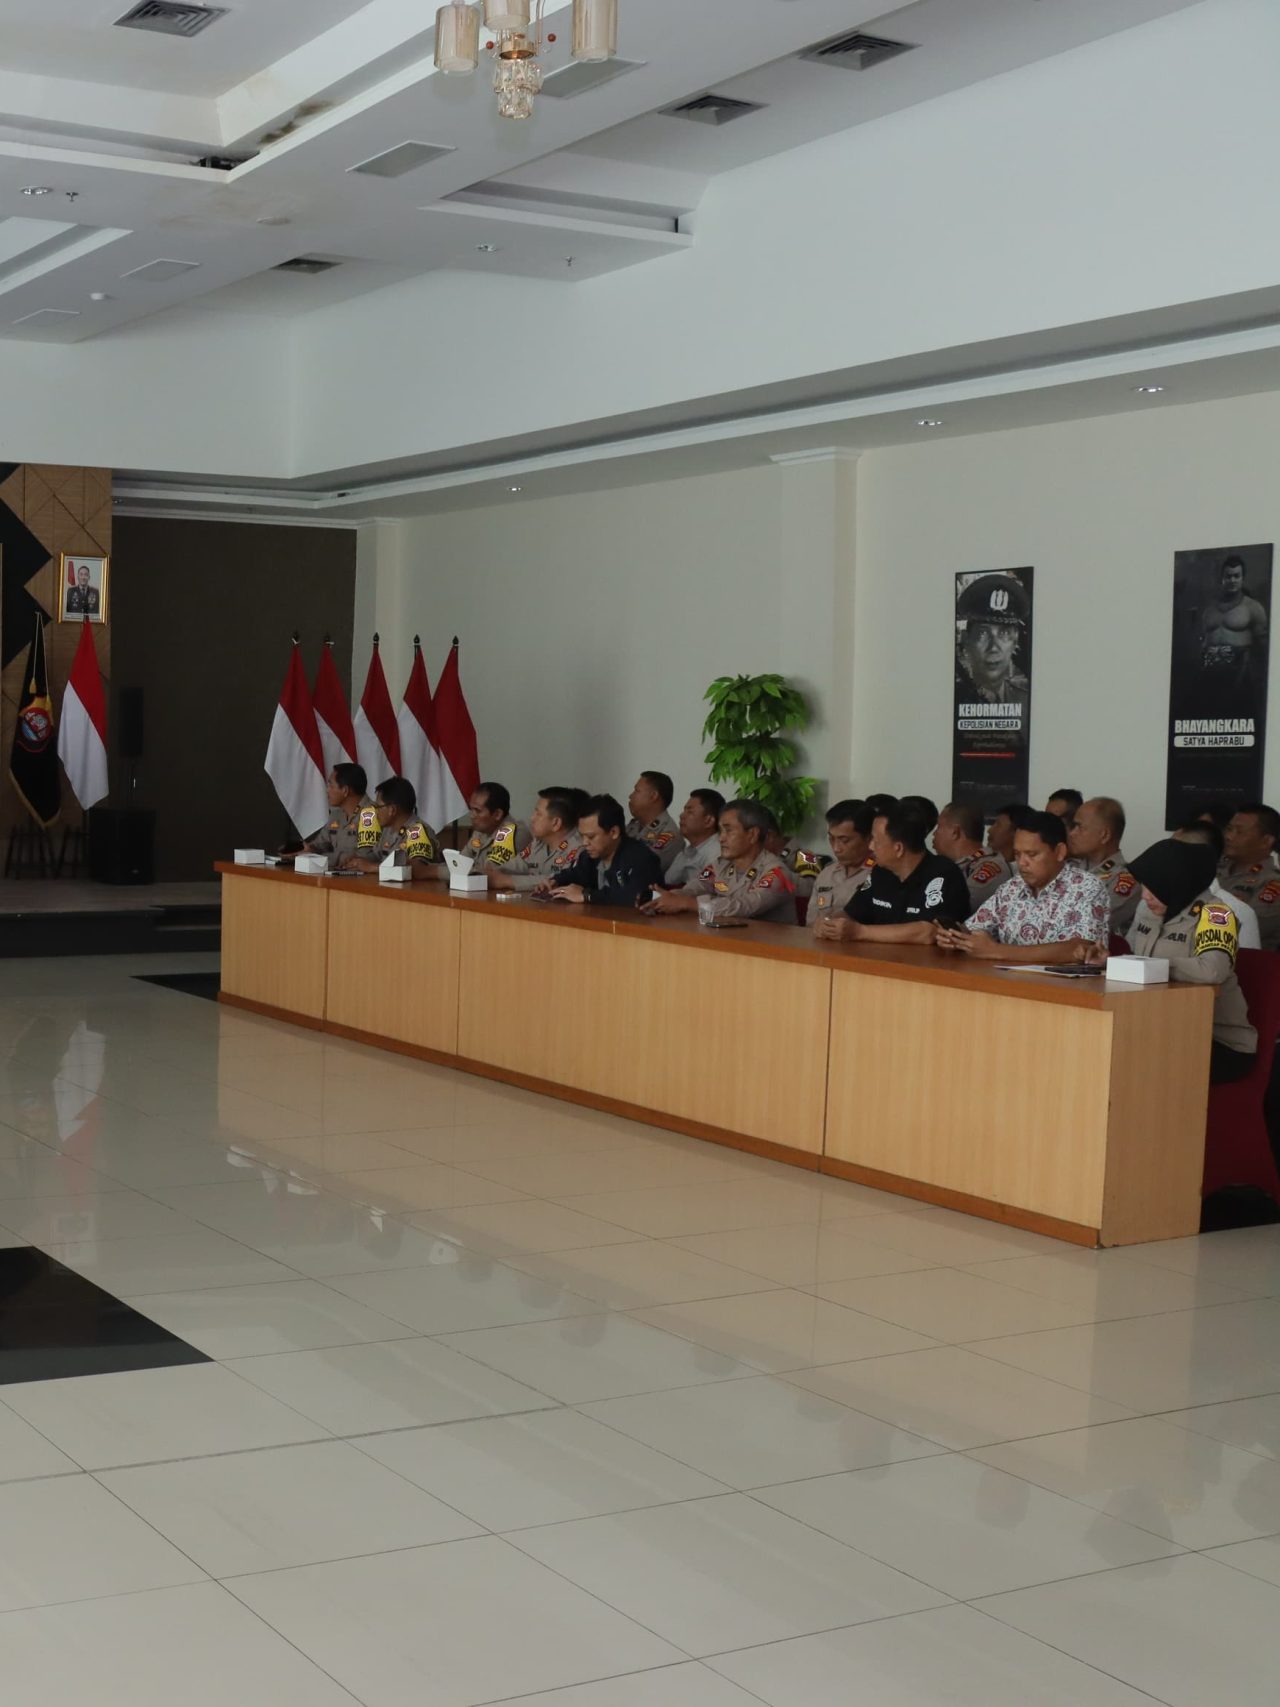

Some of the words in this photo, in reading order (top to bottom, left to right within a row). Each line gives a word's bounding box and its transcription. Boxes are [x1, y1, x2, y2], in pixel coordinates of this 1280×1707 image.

[958, 703, 1022, 717] KEHORMATAN
[960, 720, 993, 729] KEPOLISIAN
[994, 720, 1019, 729] NEGARA
[1174, 718, 1255, 734] BHAYANGKARA
[1183, 737, 1206, 746] SATYA
[1208, 736, 1245, 746] HAPRABU
